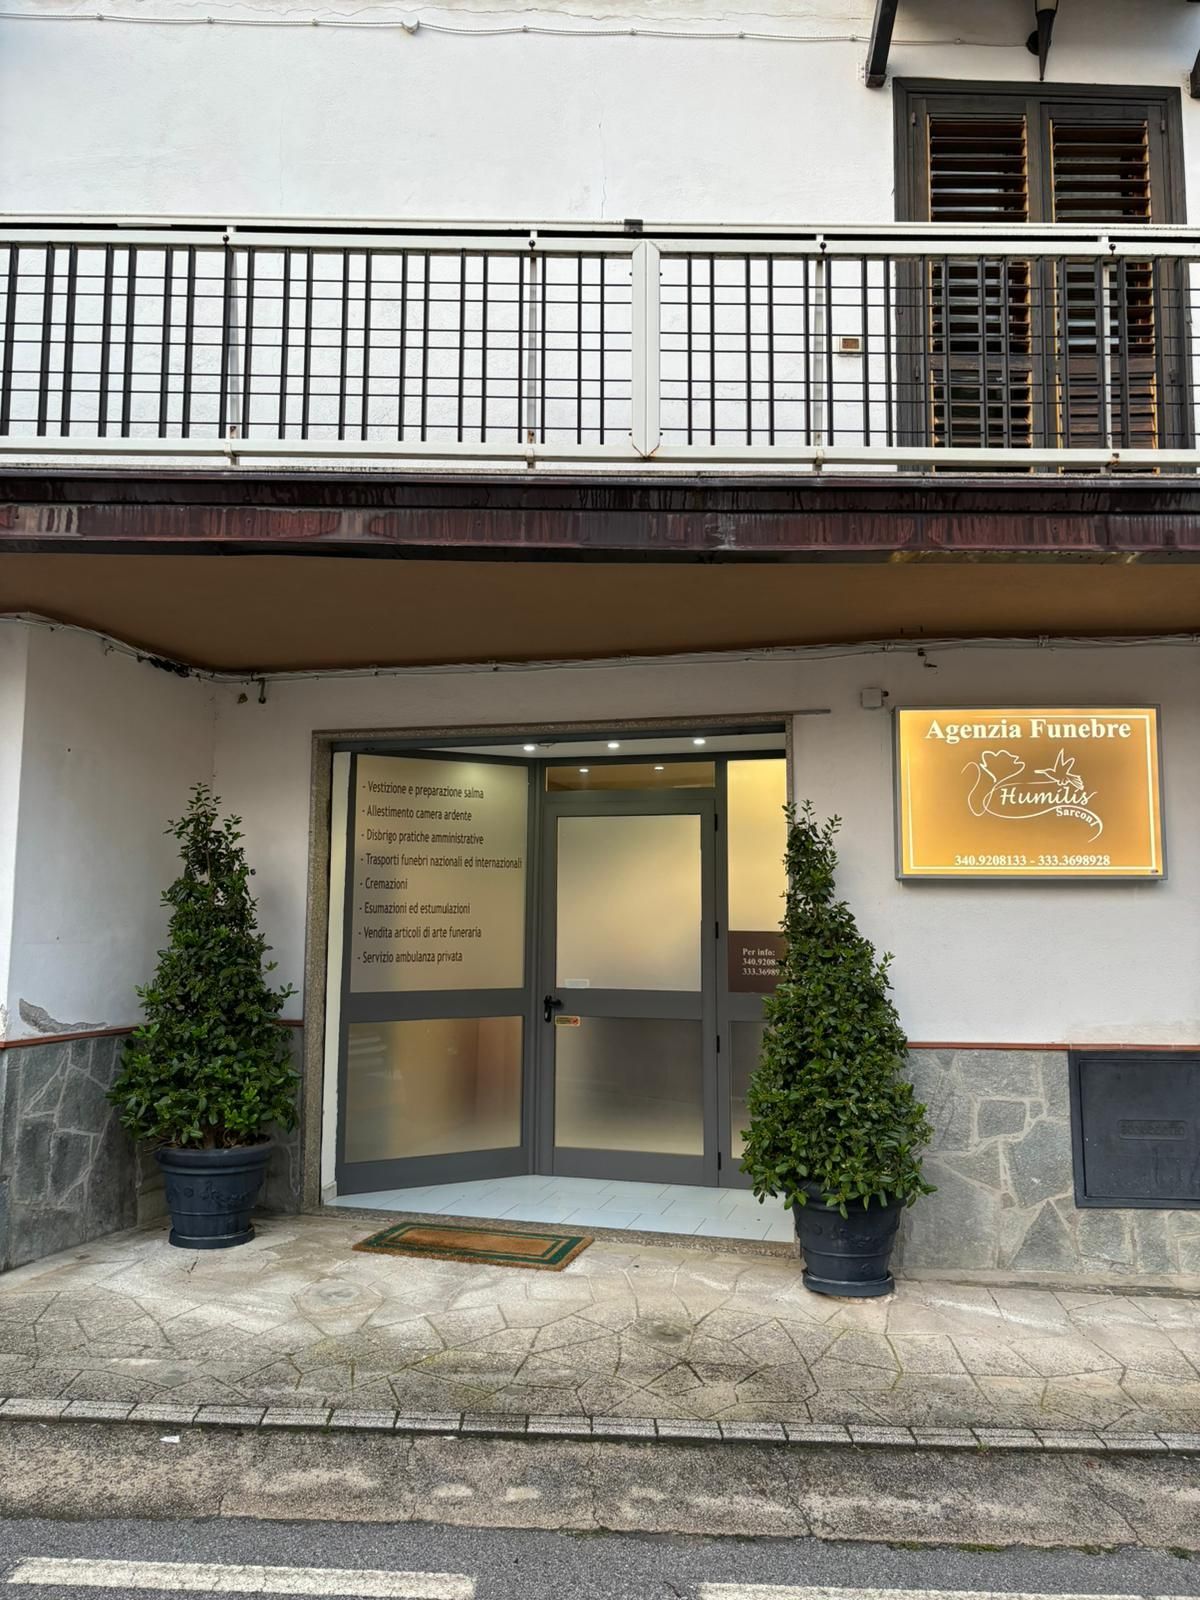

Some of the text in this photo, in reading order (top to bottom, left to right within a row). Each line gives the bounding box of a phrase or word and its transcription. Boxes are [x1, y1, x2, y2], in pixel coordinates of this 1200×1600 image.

[925, 719, 1132, 744] Agenzia Funebre
[368, 781, 407, 795] Vestizione
[408, 787, 414, 795] e
[415, 785, 463, 799] preparazione
[463, 788, 484, 799] salma
[1000, 786, 1098, 806] Humilis
[367, 805, 414, 818] Allestimento
[415, 810, 443, 820] camera
[443, 809, 473, 822] ardente
[366, 829, 397, 844] Disbrigo
[398, 831, 430, 845] pratiche
[430, 832, 484, 845] amministrative
[366, 853, 400, 868] Trasporti
[401, 855, 429, 866] funebri
[430, 856, 463, 867] nazionali
[464, 857, 474, 868] ed
[474, 857, 523, 869] internazionali
[954, 855, 1027, 866] 340.9208133
[1038, 855, 1111, 866] 333.3698928
[365, 877, 408, 890] Cremazioni
[364, 902, 407, 914] Esumazioni
[408, 903, 419, 914] ed
[420, 903, 471, 914] estumulazioni
[363, 926, 393, 939] Vendita
[394, 927, 421, 938] articoli
[422, 927, 431, 938] di
[431, 928, 447, 938] arte
[448, 926, 482, 938] funeraria
[362, 951, 394, 963] Servizio
[395, 951, 436, 963] ambulanza
[437, 952, 463, 965] privata
[757, 948, 775, 956] info:
[742, 958, 780, 966] 340.9208
[742, 967, 786, 976] 333.36989
